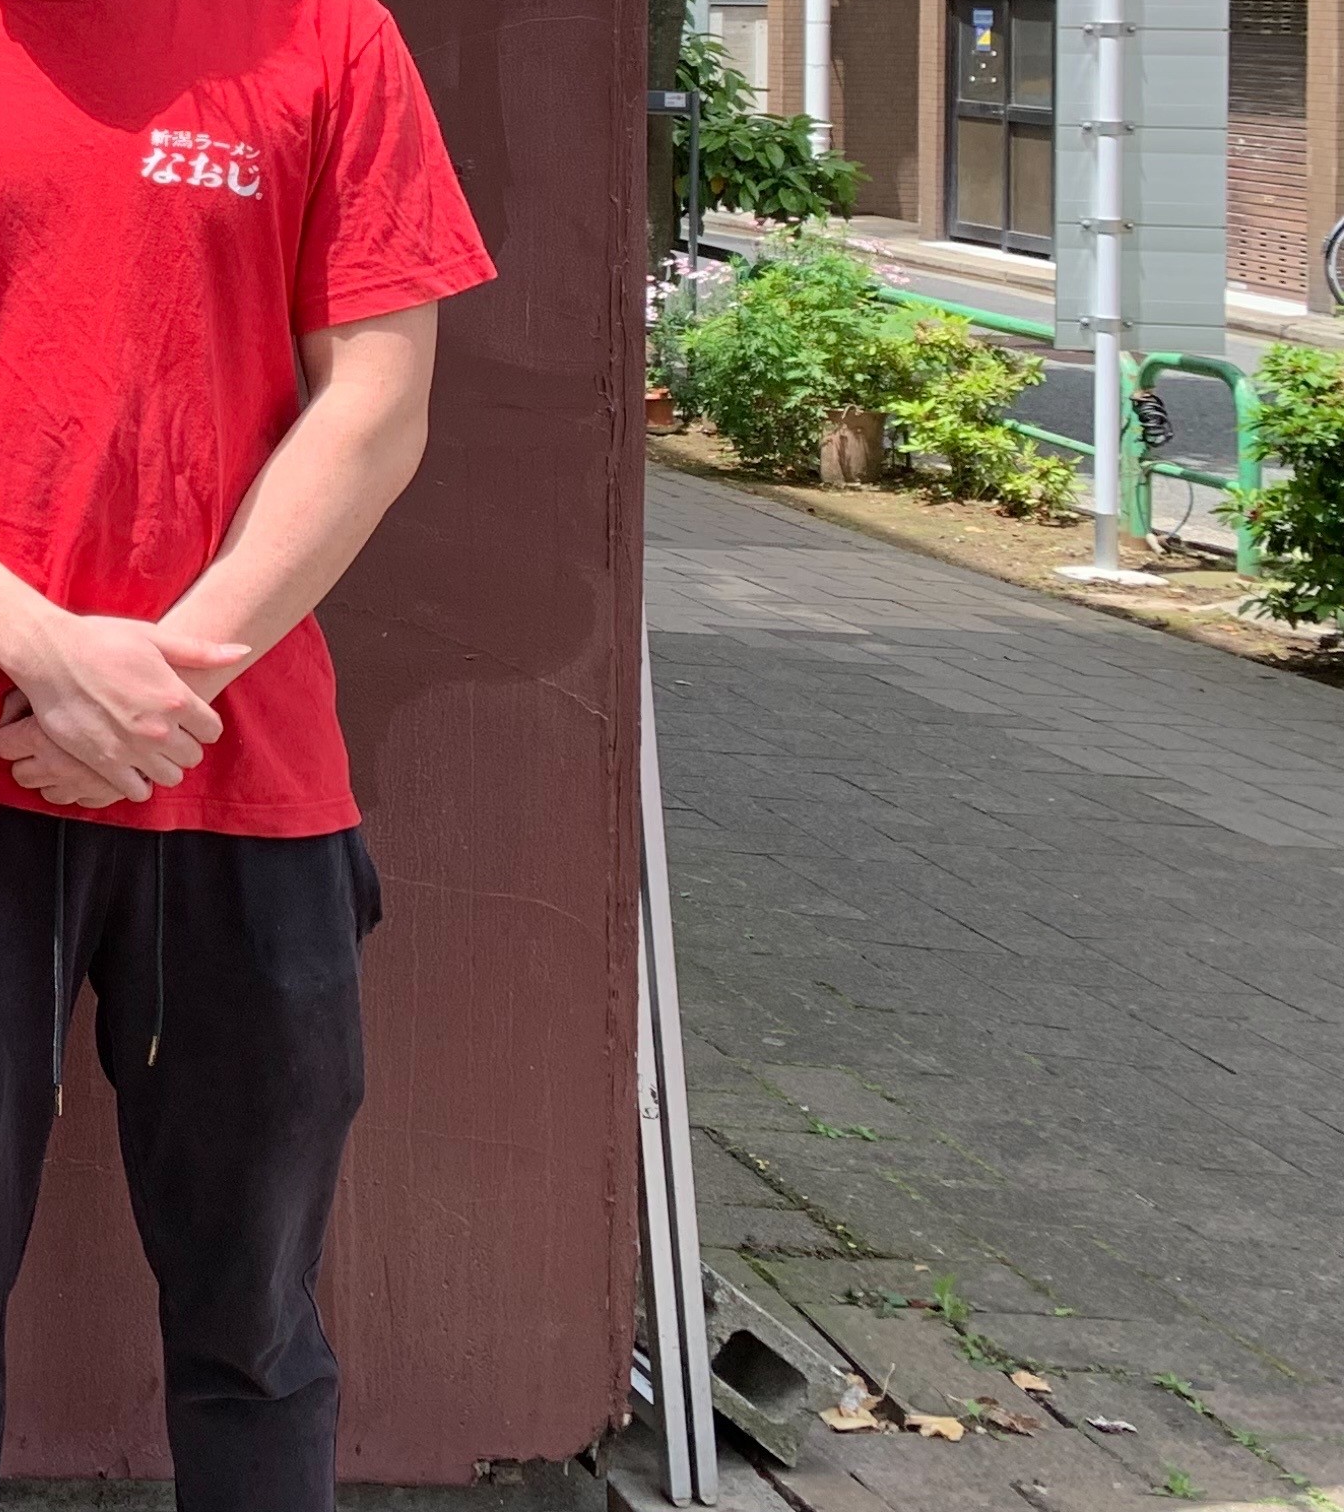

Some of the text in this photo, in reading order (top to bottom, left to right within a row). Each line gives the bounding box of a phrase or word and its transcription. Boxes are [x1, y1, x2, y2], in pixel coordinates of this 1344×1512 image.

[151, 129, 260, 159] 新潟ラーメン
